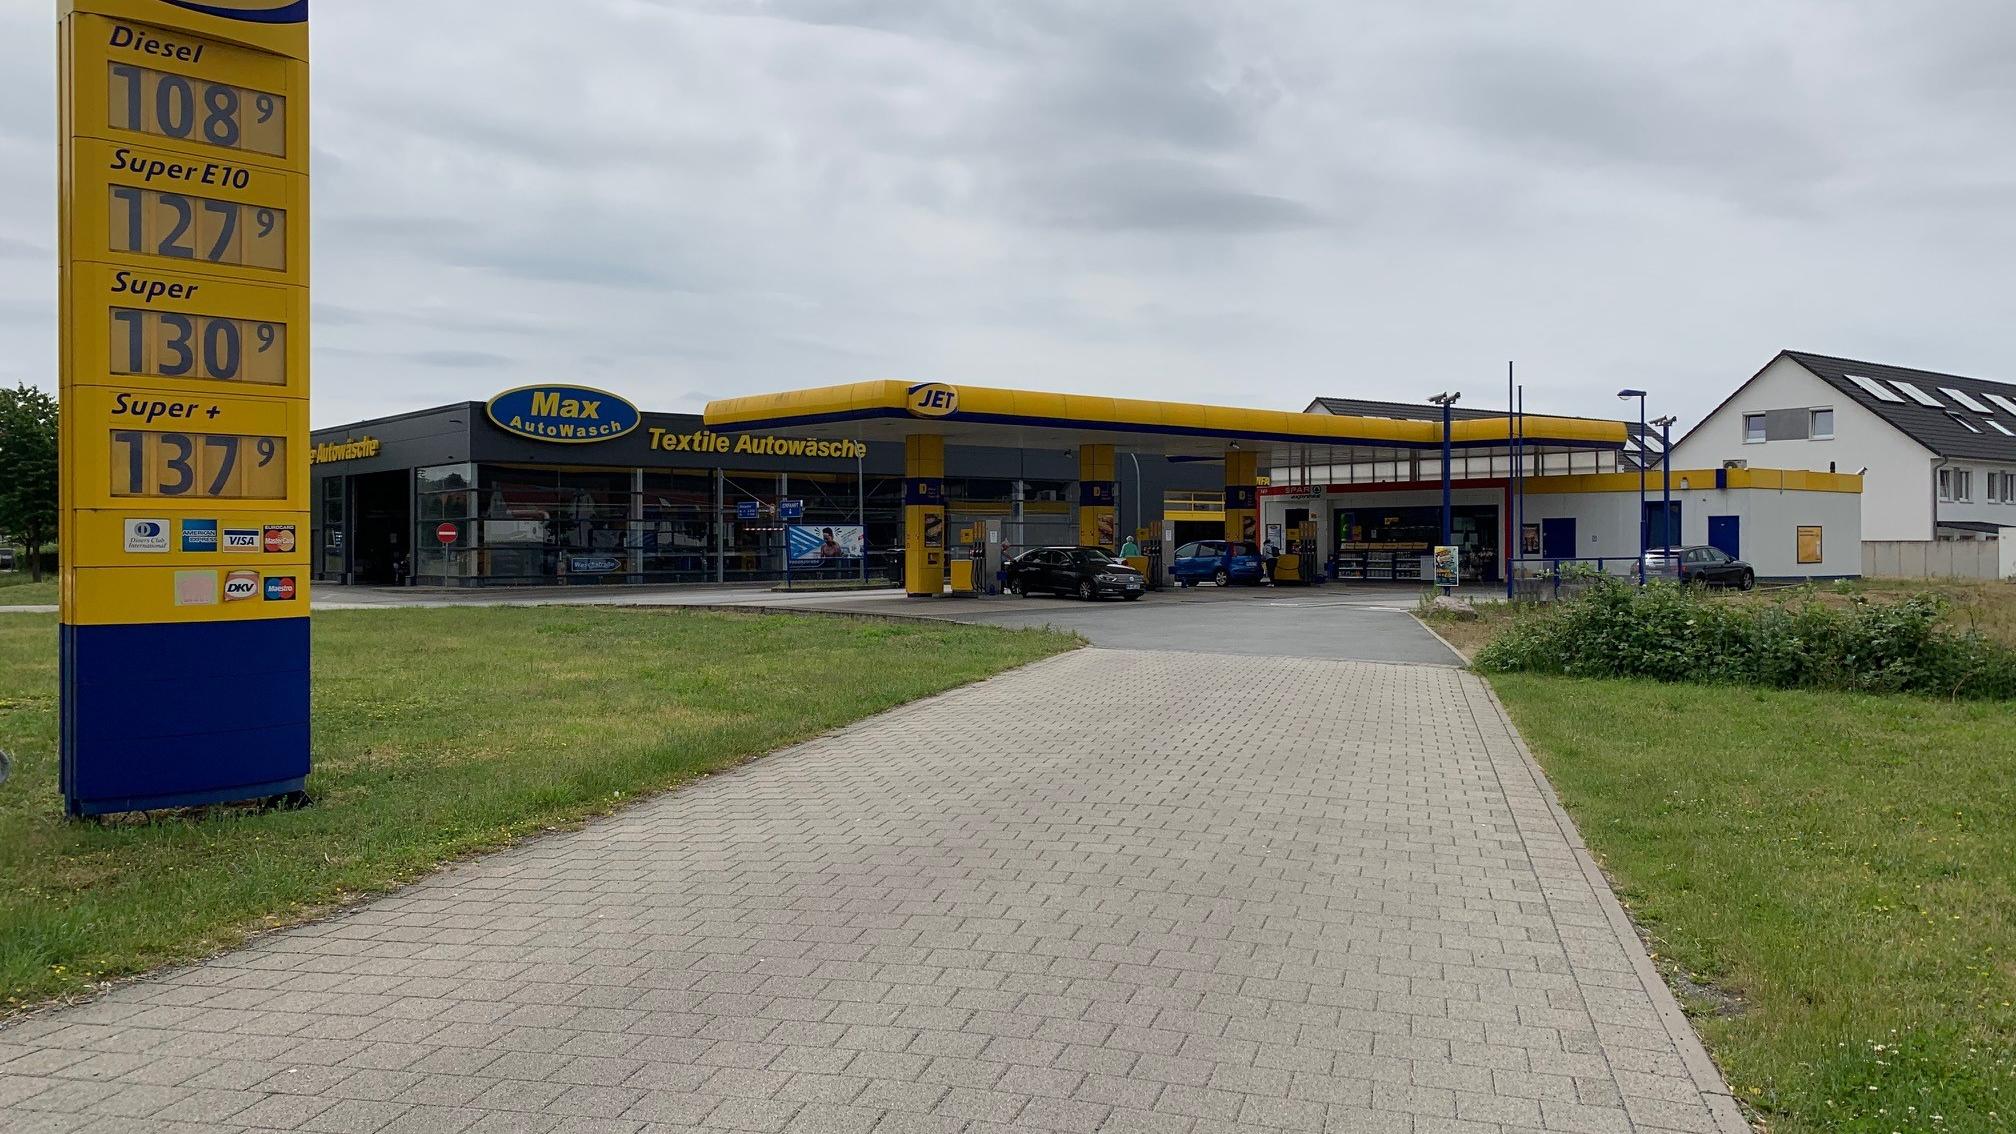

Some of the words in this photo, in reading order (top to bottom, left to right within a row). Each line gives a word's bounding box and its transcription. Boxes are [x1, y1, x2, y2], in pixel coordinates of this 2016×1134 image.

[109, 25, 203, 63] Diesel
[110, 148, 197, 182] Super
[201, 163, 249, 189] E10
[111, 271, 198, 302] Super
[111, 393, 199, 423] Super
[206, 406, 220, 419] +
[530, 391, 601, 419] Max
[918, 390, 954, 408] JET
[509, 415, 622, 438] AutoWasch
[316, 435, 379, 463] Autowäsche
[648, 427, 729, 453] Textile
[733, 434, 867, 459] Autowäsche
[1284, 486, 1310, 494] SPAR
[229, 536, 255, 546] VISA
[227, 583, 255, 593] DKV
